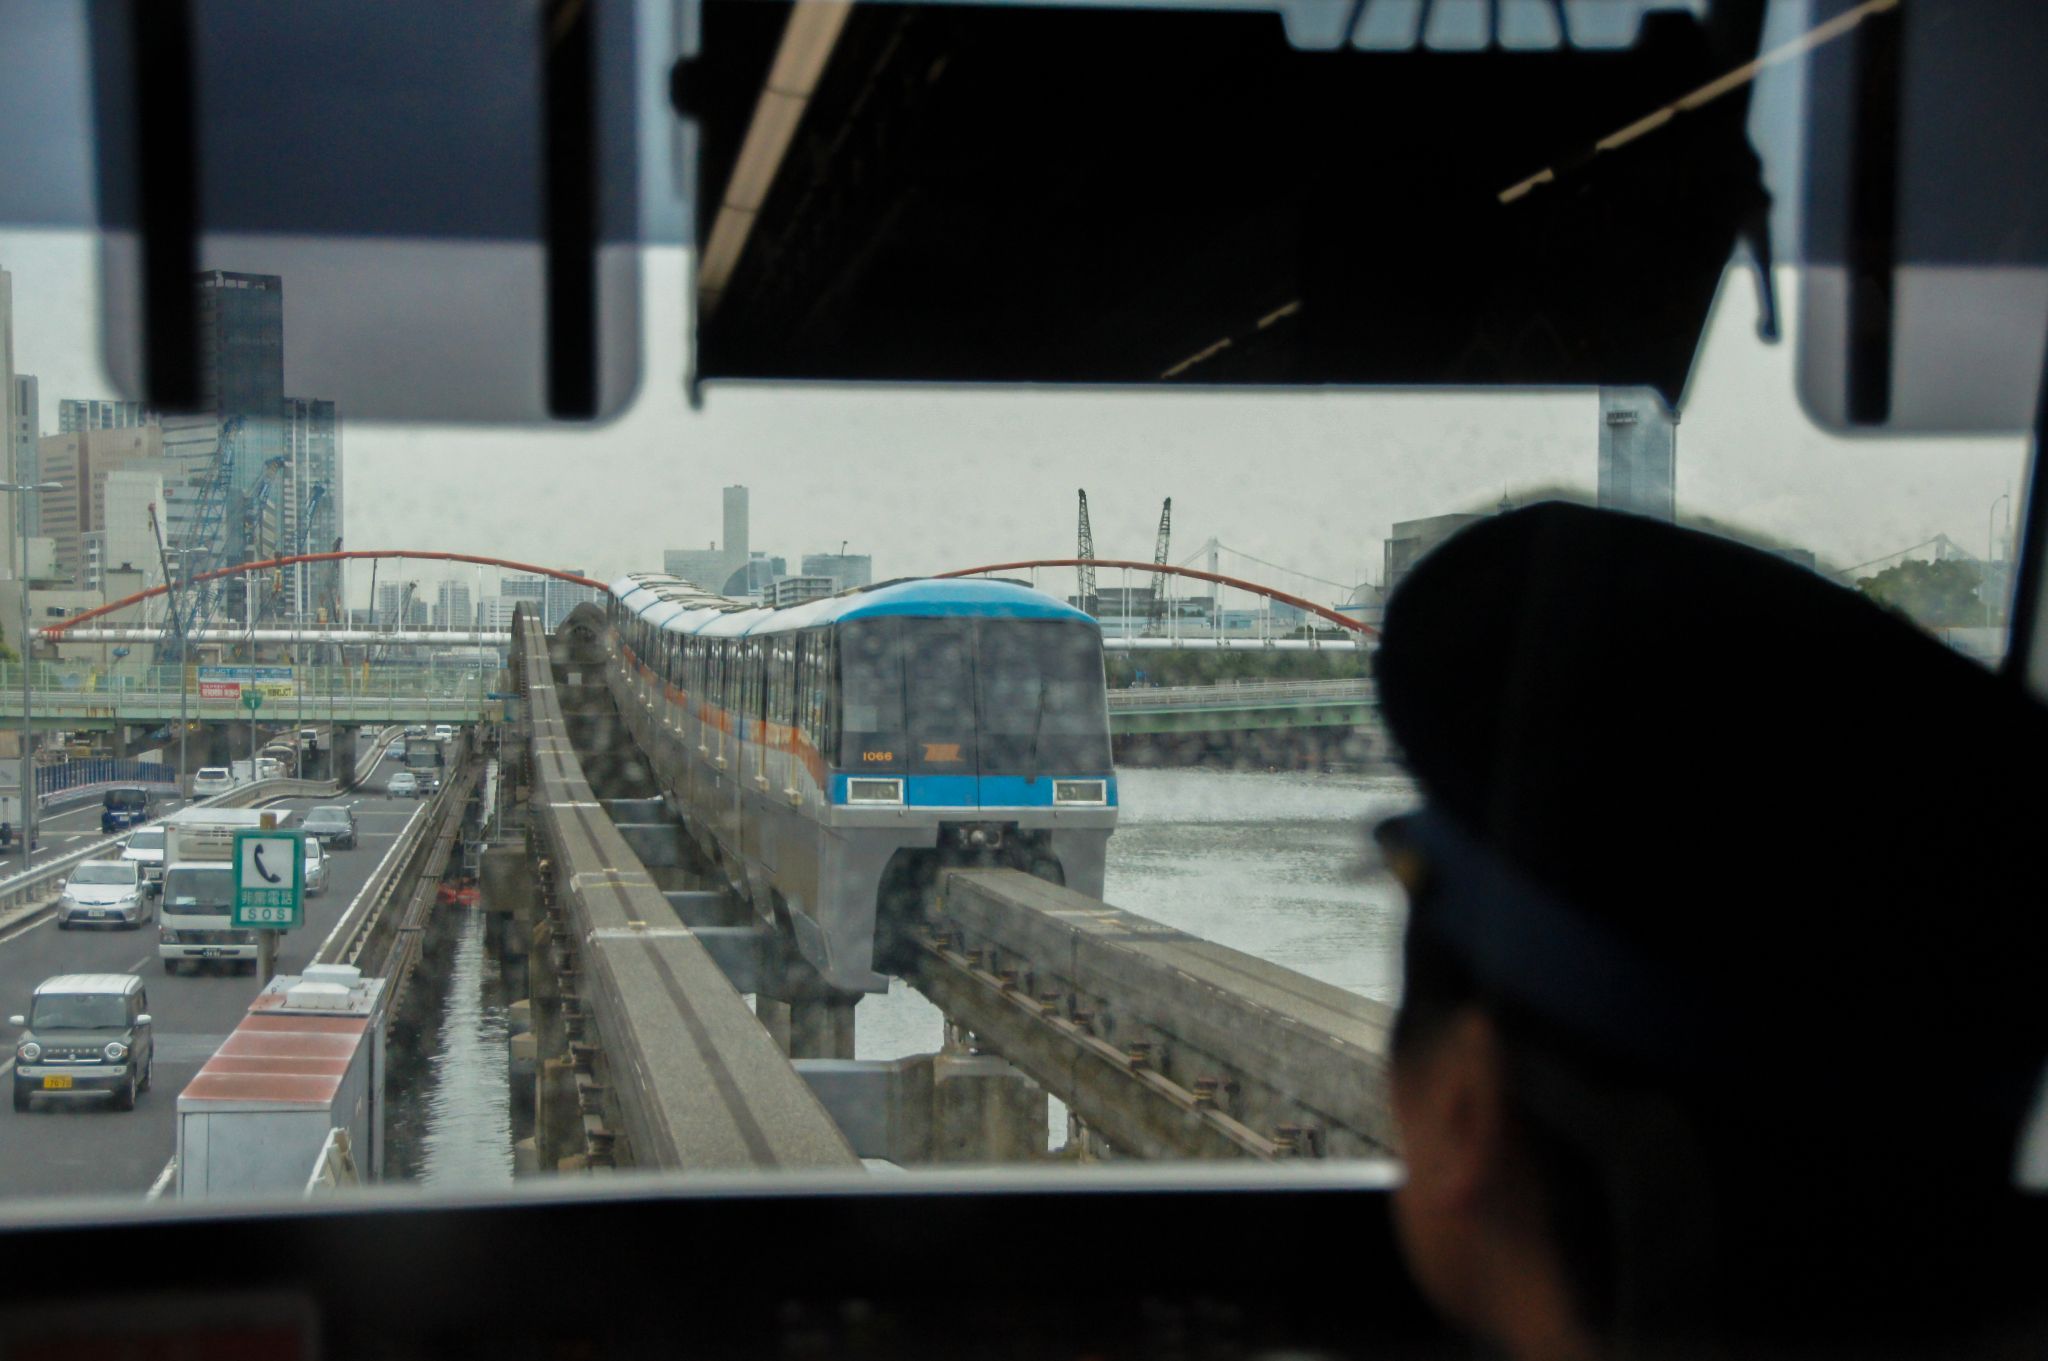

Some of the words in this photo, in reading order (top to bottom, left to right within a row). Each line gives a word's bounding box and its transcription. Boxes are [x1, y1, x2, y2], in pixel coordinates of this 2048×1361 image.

[863, 751, 893, 761] 1066
[241, 889, 293, 905] 非常電話
[248, 908, 285, 920] SOS
